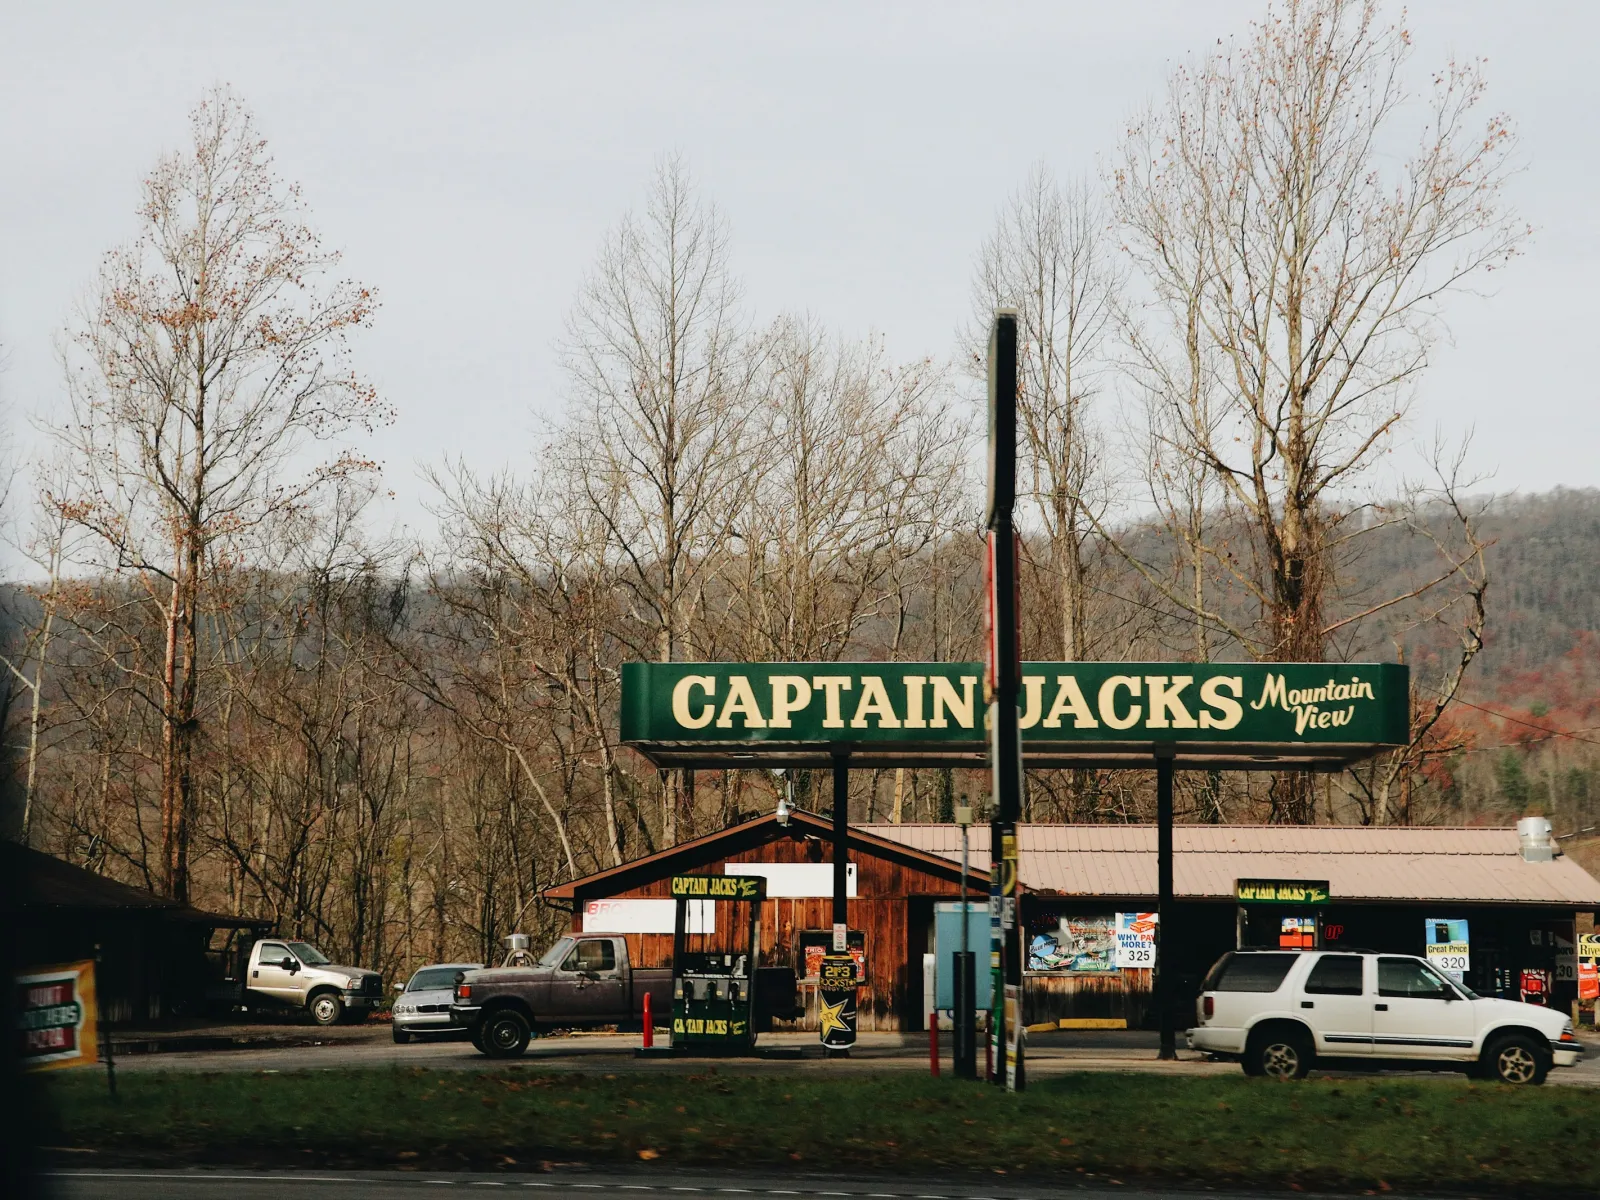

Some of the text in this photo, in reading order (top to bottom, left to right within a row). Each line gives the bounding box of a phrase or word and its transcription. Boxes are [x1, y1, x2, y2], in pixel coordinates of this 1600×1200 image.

[1250, 673, 1375, 712] Mountain
[672, 675, 1243, 731] CAPTAIN JACKS
[1291, 704, 1354, 736] View
[672, 877, 708, 895] CAPTAIN
[709, 879, 737, 896] JACKS
[1238, 883, 1276, 900] CAPTAIN
[1277, 884, 1306, 901] JACKS
[1140, 934, 1155, 942] PAY
[1128, 950, 1150, 961] 325
[1428, 945, 1467, 954] Great Price
[1441, 957, 1466, 969] 320
[705, 1019, 728, 1035] JACKS
